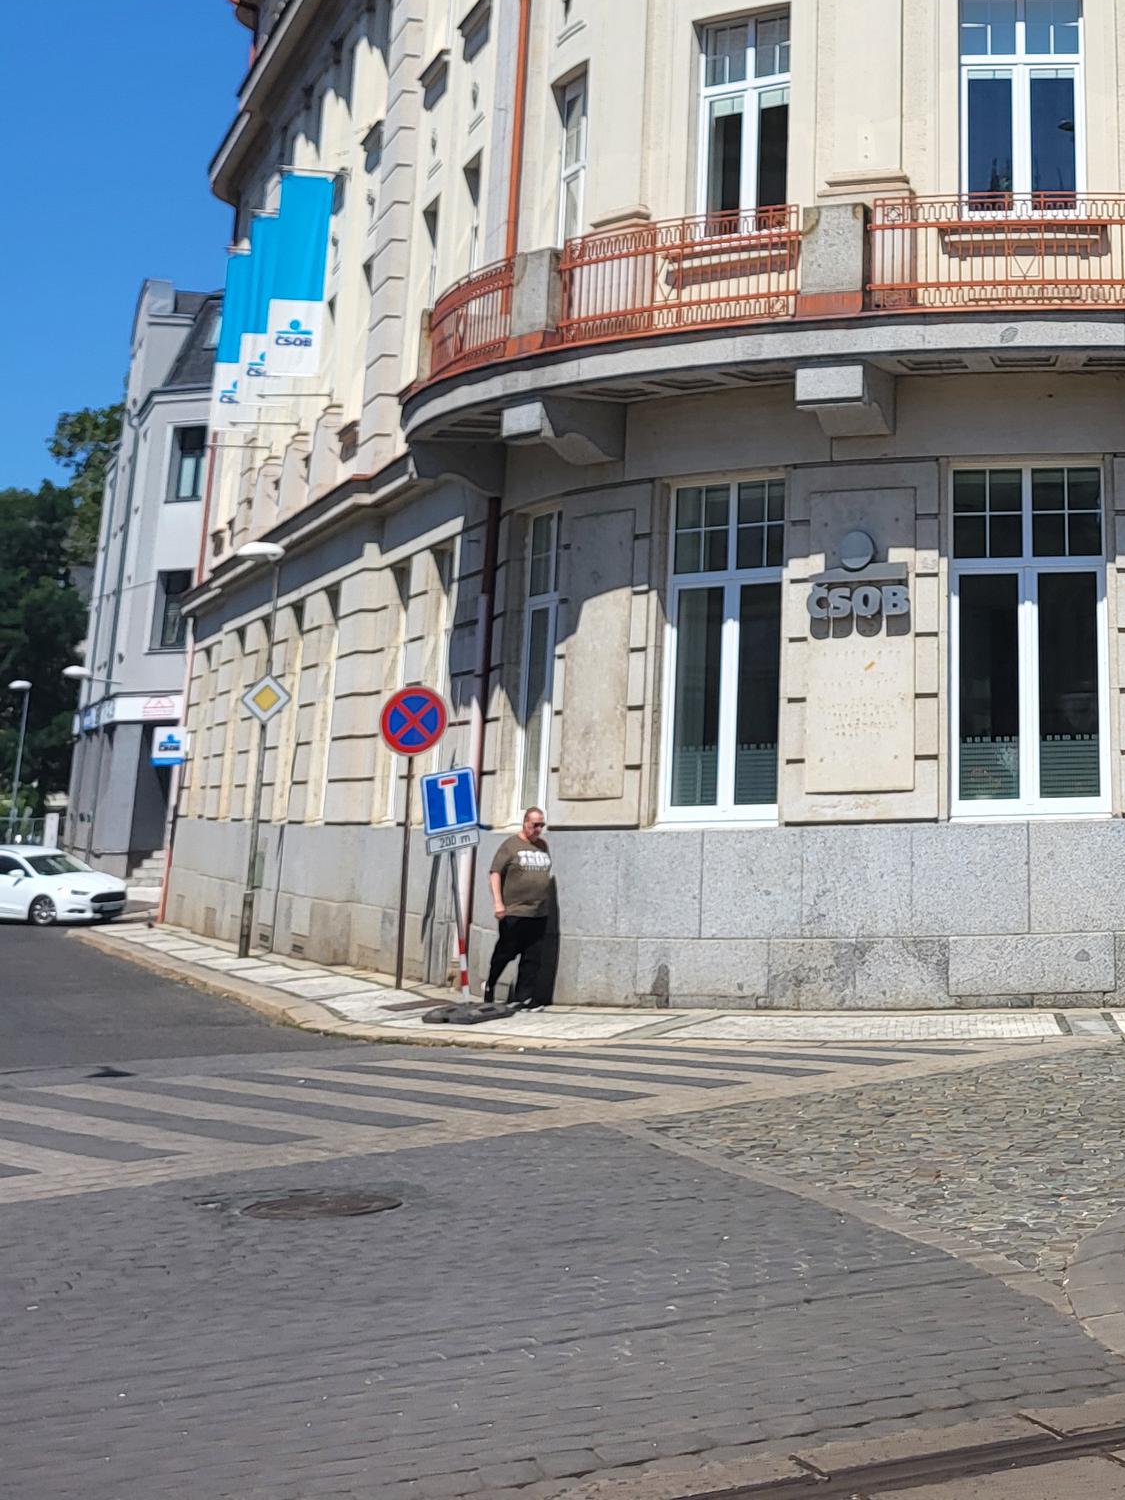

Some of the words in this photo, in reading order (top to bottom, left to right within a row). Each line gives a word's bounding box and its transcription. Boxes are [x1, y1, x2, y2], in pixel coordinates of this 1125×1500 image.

[275, 335, 312, 347] ČSOB
[807, 583, 911, 618] ČSOB
[440, 835, 457, 848] 200
[460, 834, 471, 844] m
